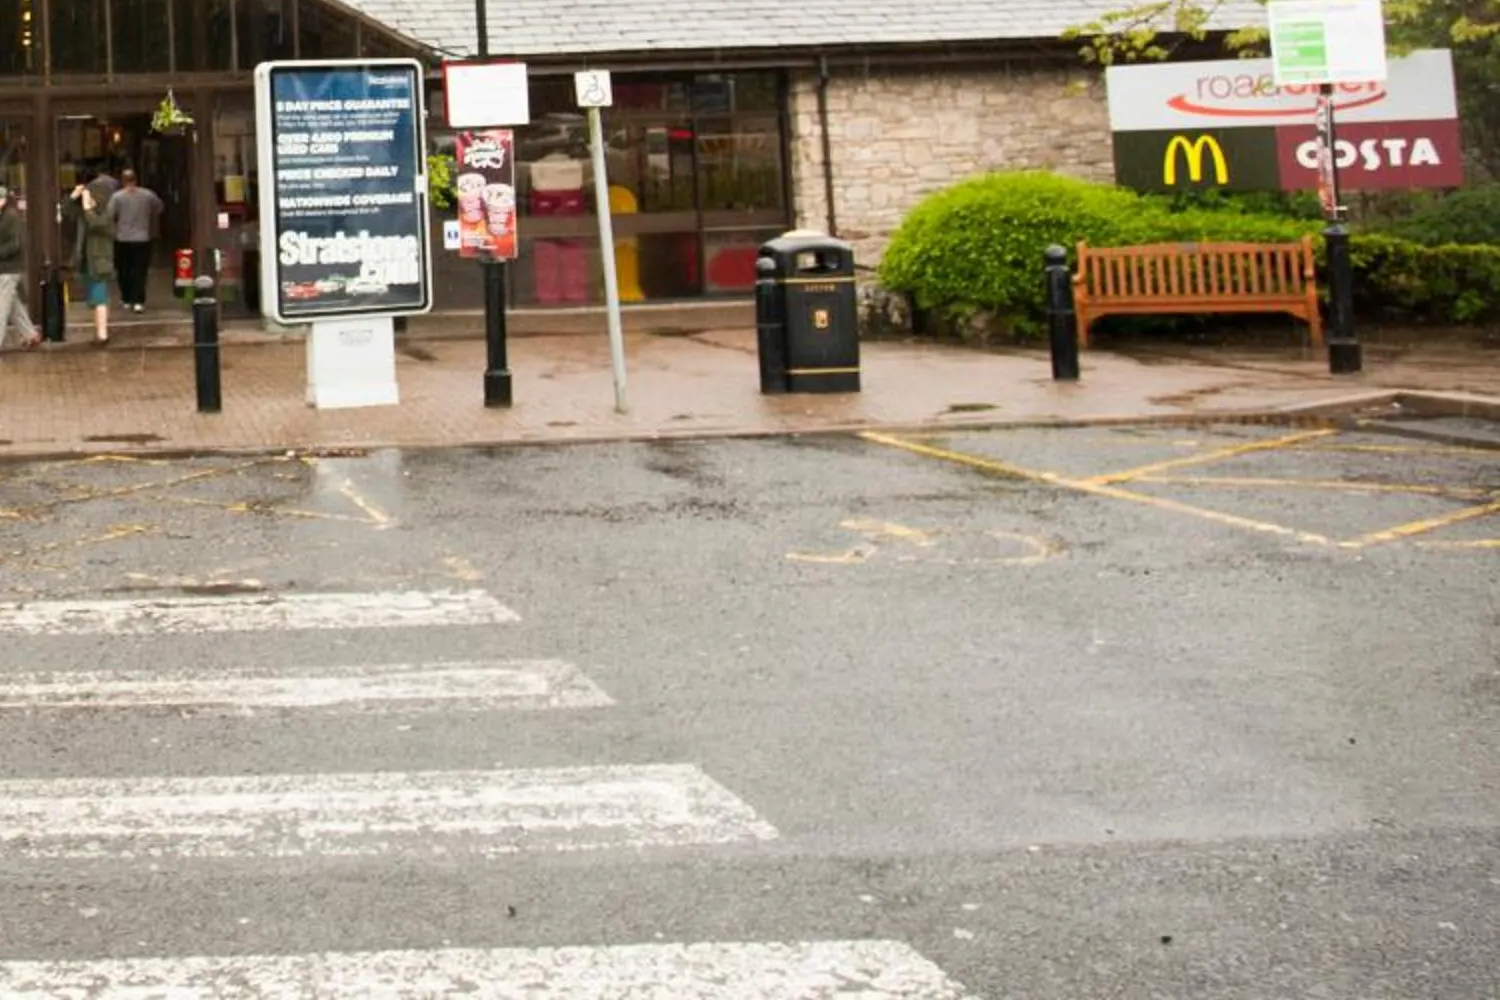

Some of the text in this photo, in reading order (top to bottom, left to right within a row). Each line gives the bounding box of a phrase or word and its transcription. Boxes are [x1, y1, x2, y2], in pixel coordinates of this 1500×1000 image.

[1296, 138, 1442, 171] COSTA
[366, 166, 399, 177] DAILY
[279, 195, 350, 208] NATIONWIDE
[279, 230, 418, 265] Stratstone
